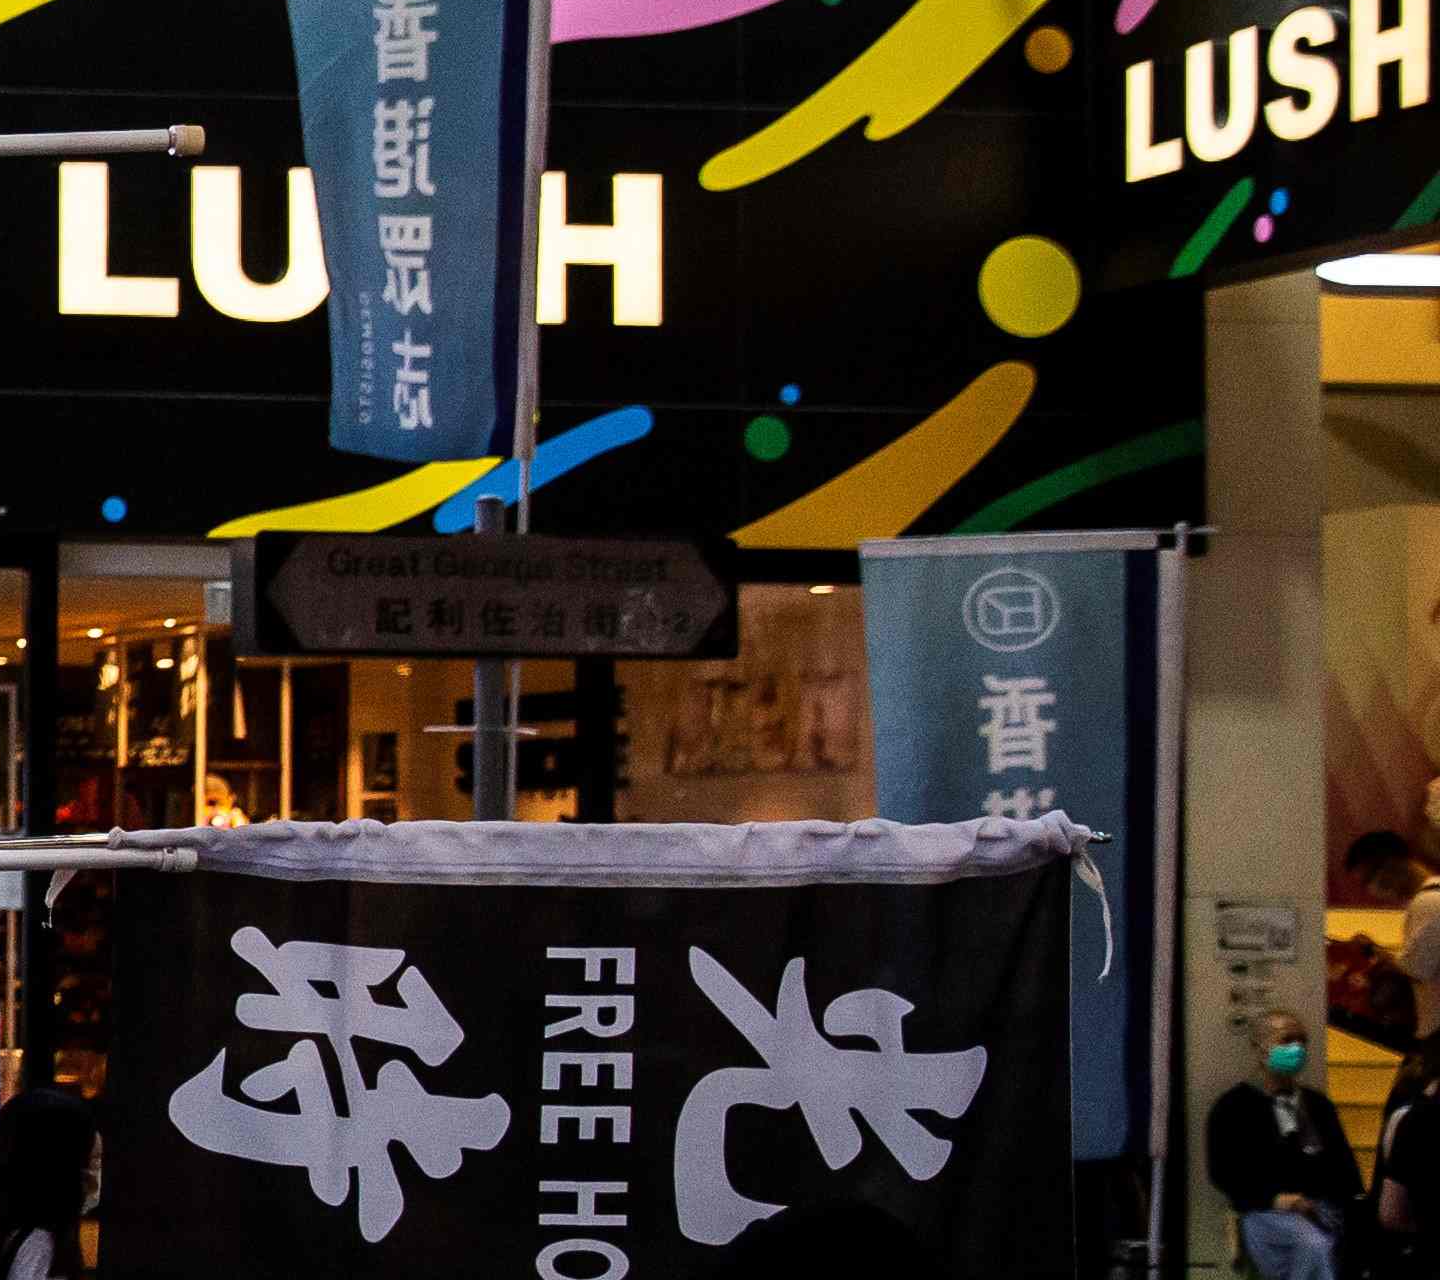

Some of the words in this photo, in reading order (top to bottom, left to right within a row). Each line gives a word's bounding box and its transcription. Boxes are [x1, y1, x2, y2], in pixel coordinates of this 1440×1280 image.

[57, 160, 665, 327] LUH
[326, 551, 422, 578] Great
[433, 552, 554, 588] George
[564, 554, 670, 582] Street
[537, 946, 637, 1145] FREE
